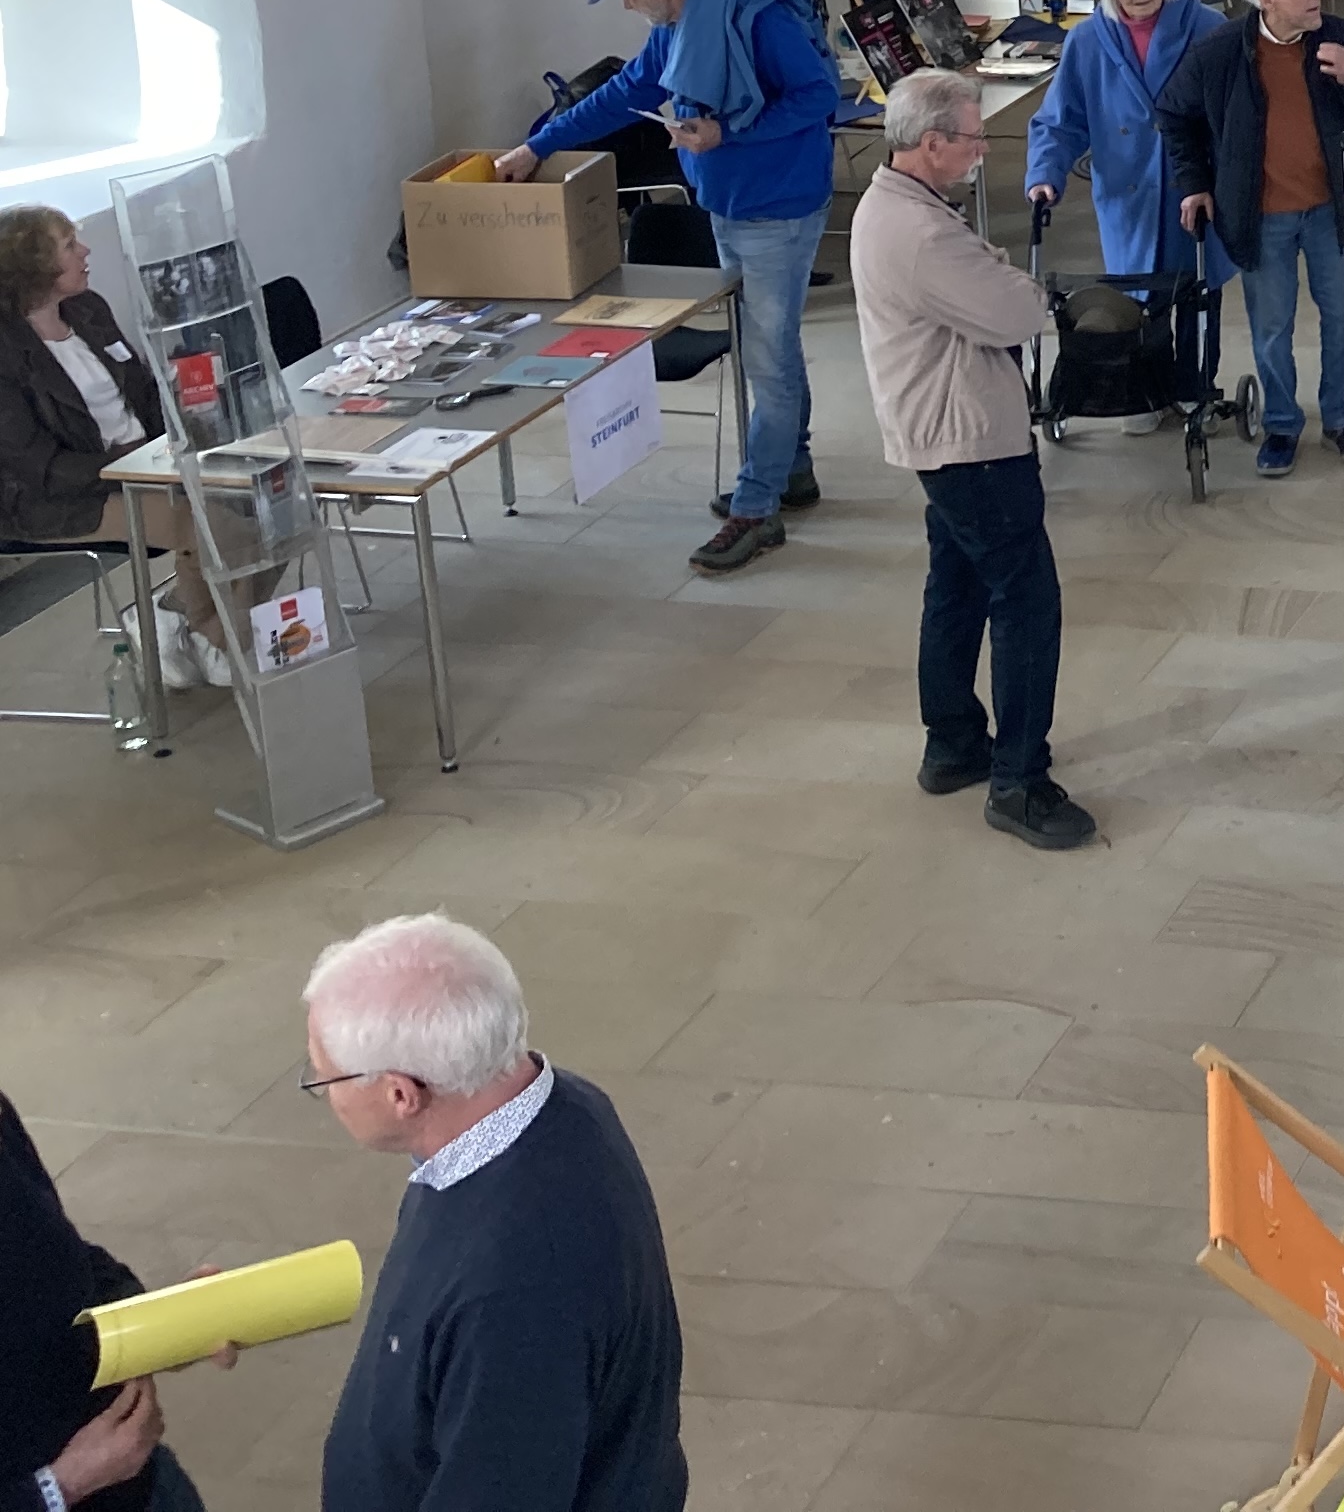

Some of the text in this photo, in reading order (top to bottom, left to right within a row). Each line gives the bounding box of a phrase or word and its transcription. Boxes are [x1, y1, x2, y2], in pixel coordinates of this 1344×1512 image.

[417, 201, 563, 230] Zu verschenken
[591, 406, 640, 448] STEINFURT
